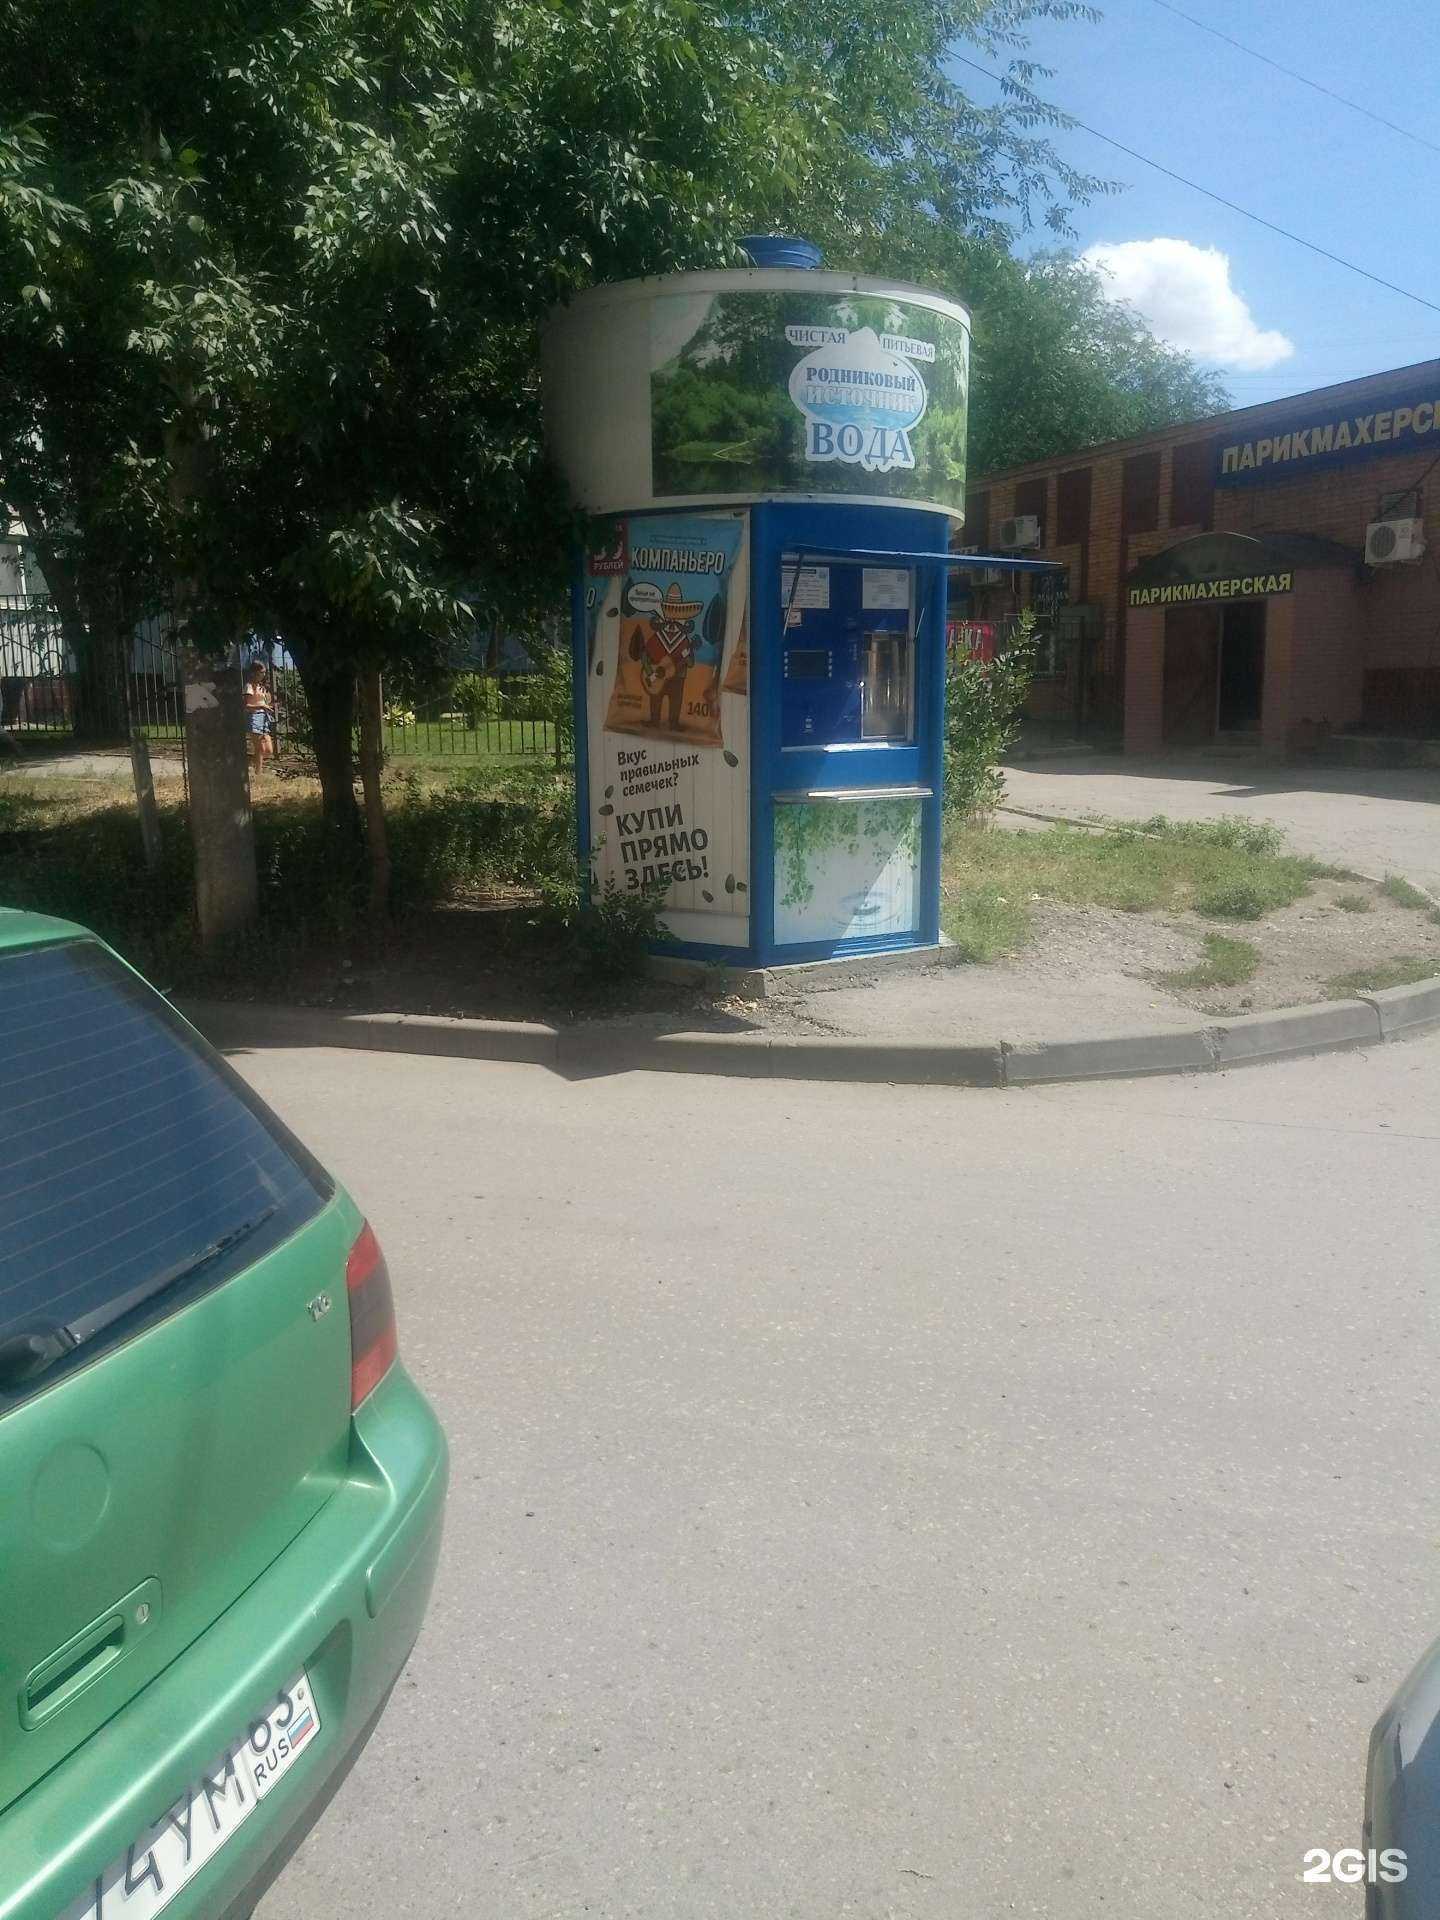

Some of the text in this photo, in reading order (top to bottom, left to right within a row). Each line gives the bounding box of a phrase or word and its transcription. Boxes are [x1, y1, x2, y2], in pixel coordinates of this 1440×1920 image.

[788, 329, 934, 358] ЧИСТАЯ ПИТЬЕВАЯ
[806, 367, 917, 392] РОДНИКОВЫЙ
[806, 386, 917, 413] ИСТОЧНИК
[811, 422, 911, 465] ВОДА
[631, 547, 725, 574] КОМПАНЬЕРО
[1130, 573, 1292, 605] ПАРИКМАХЕРСКАЯ
[617, 749, 647, 766] Вкус
[620, 753, 700, 783] правильных
[623, 772, 679, 797] семечек?
[616, 803, 684, 837] КУПИ
[620, 828, 709, 863] ПРЯМО
[254, 1738, 289, 1787] RUS
